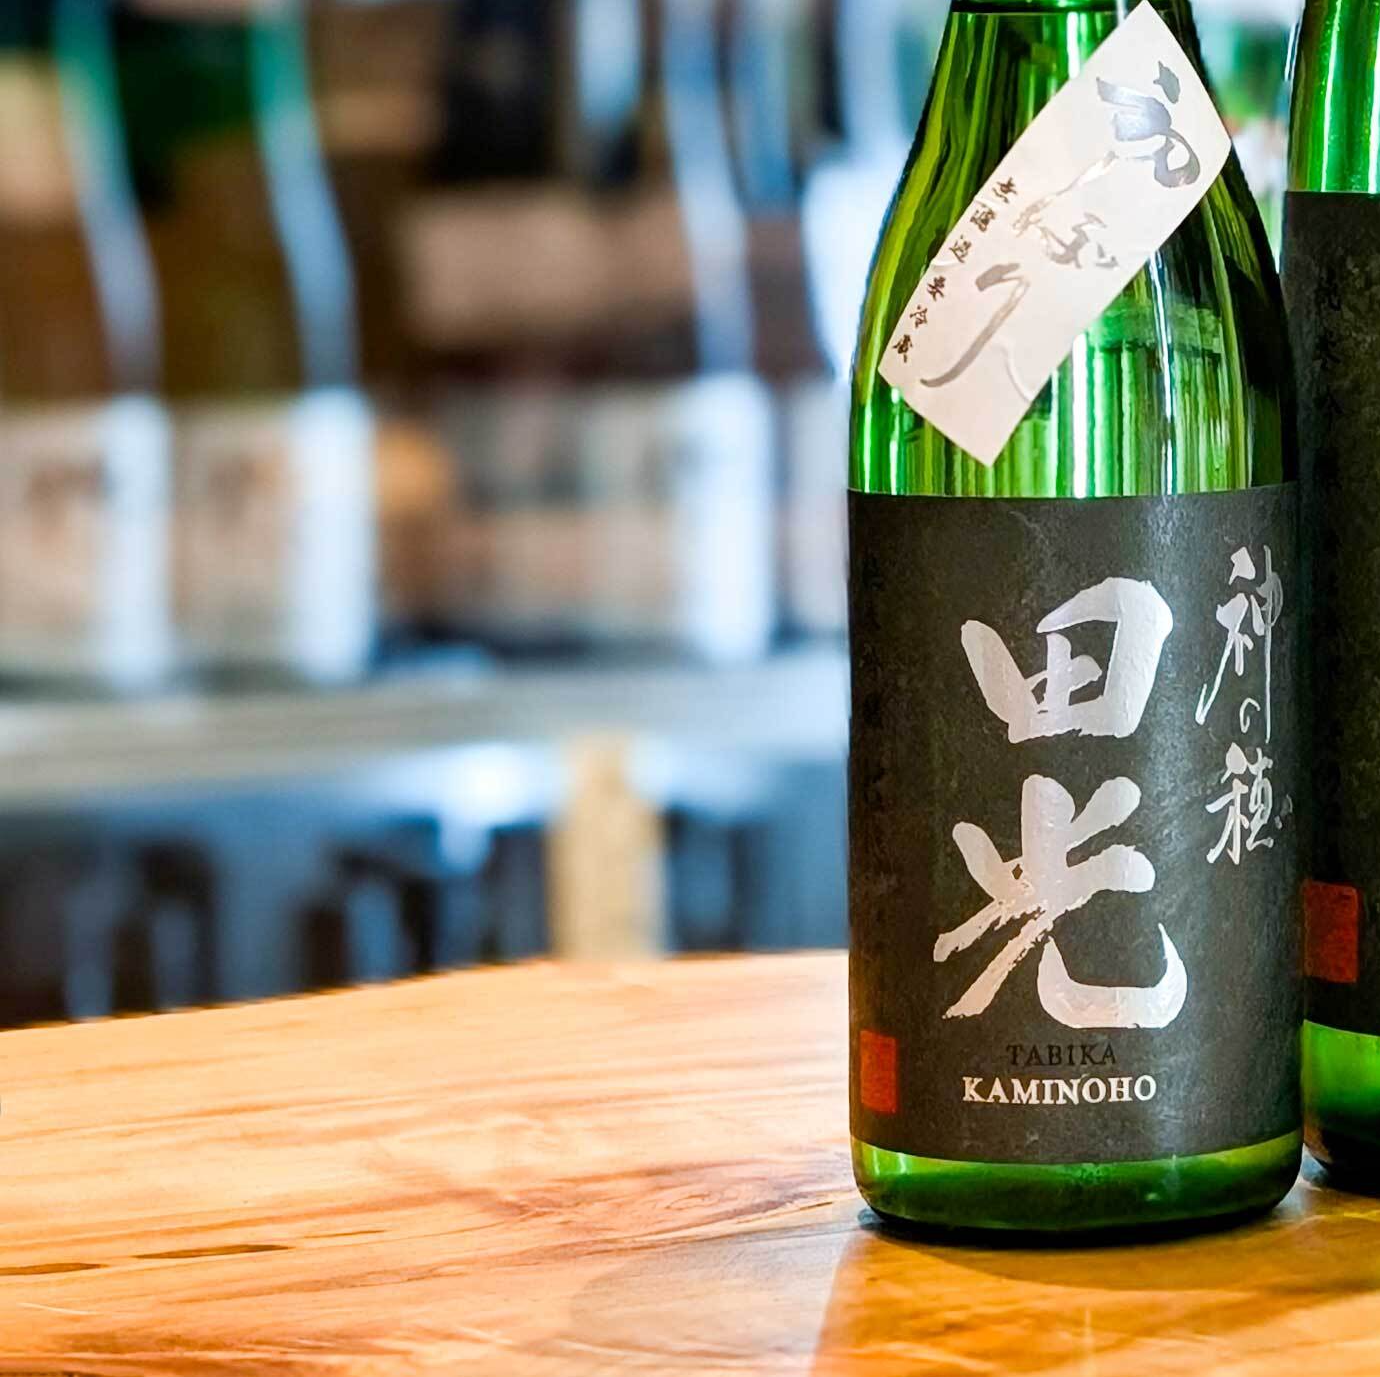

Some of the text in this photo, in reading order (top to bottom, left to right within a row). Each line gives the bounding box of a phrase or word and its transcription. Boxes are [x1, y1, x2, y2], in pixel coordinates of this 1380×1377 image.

[933, 577, 1188, 1029] 田光
[1006, 1043, 1118, 1069] TABIKA
[962, 1075, 1158, 1106] KAMINOHO
